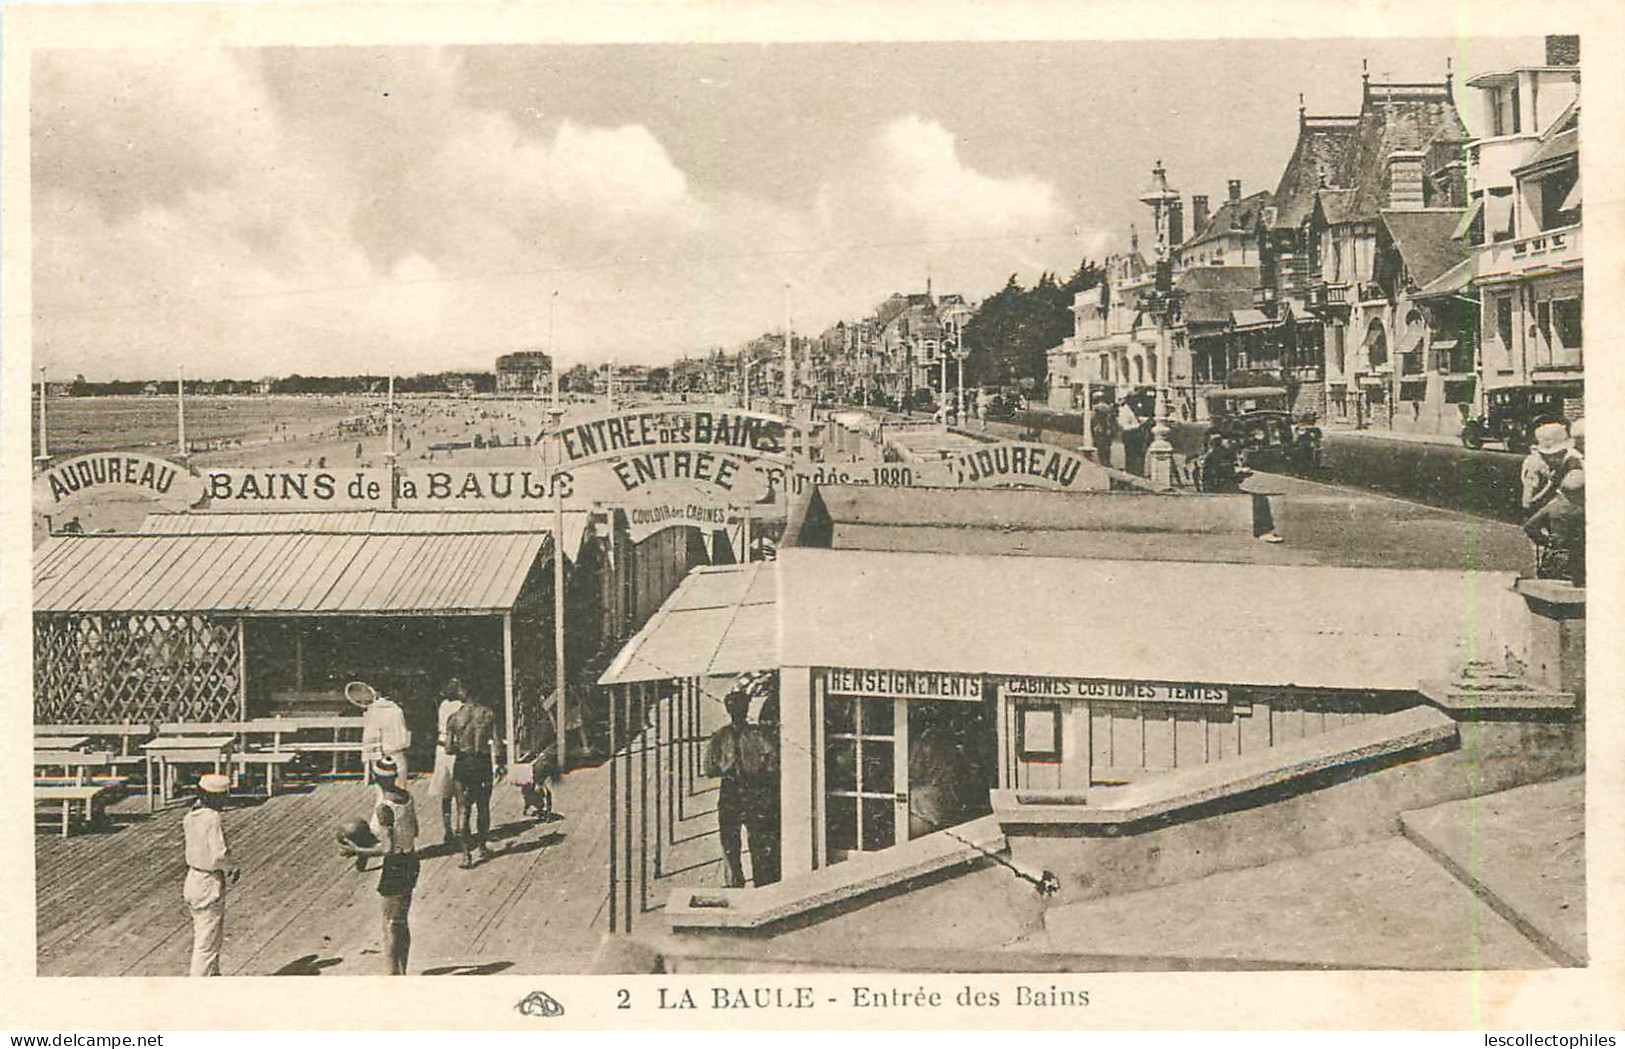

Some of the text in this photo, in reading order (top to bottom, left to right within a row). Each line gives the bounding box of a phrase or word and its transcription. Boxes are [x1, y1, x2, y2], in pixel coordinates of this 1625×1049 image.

[561, 413, 657, 460] ENTREE
[660, 427, 691, 443] DES
[48, 457, 177, 503] AUDUREAU
[208, 473, 336, 500] BAINS
[347, 473, 381, 500] de
[395, 472, 417, 499] la
[427, 472, 574, 499] BAULE
[873, 468, 912, 487] 1880
[613, 450, 740, 491] ENTRÉE
[948, 447, 1081, 487] UDUREAU
[632, 505, 670, 523] COULOIR
[686, 504, 724, 523] CABINES
[832, 668, 980, 697] RENSEIGNEMENTS
[1008, 679, 1223, 700] CABINES COSTUMES TENTES
